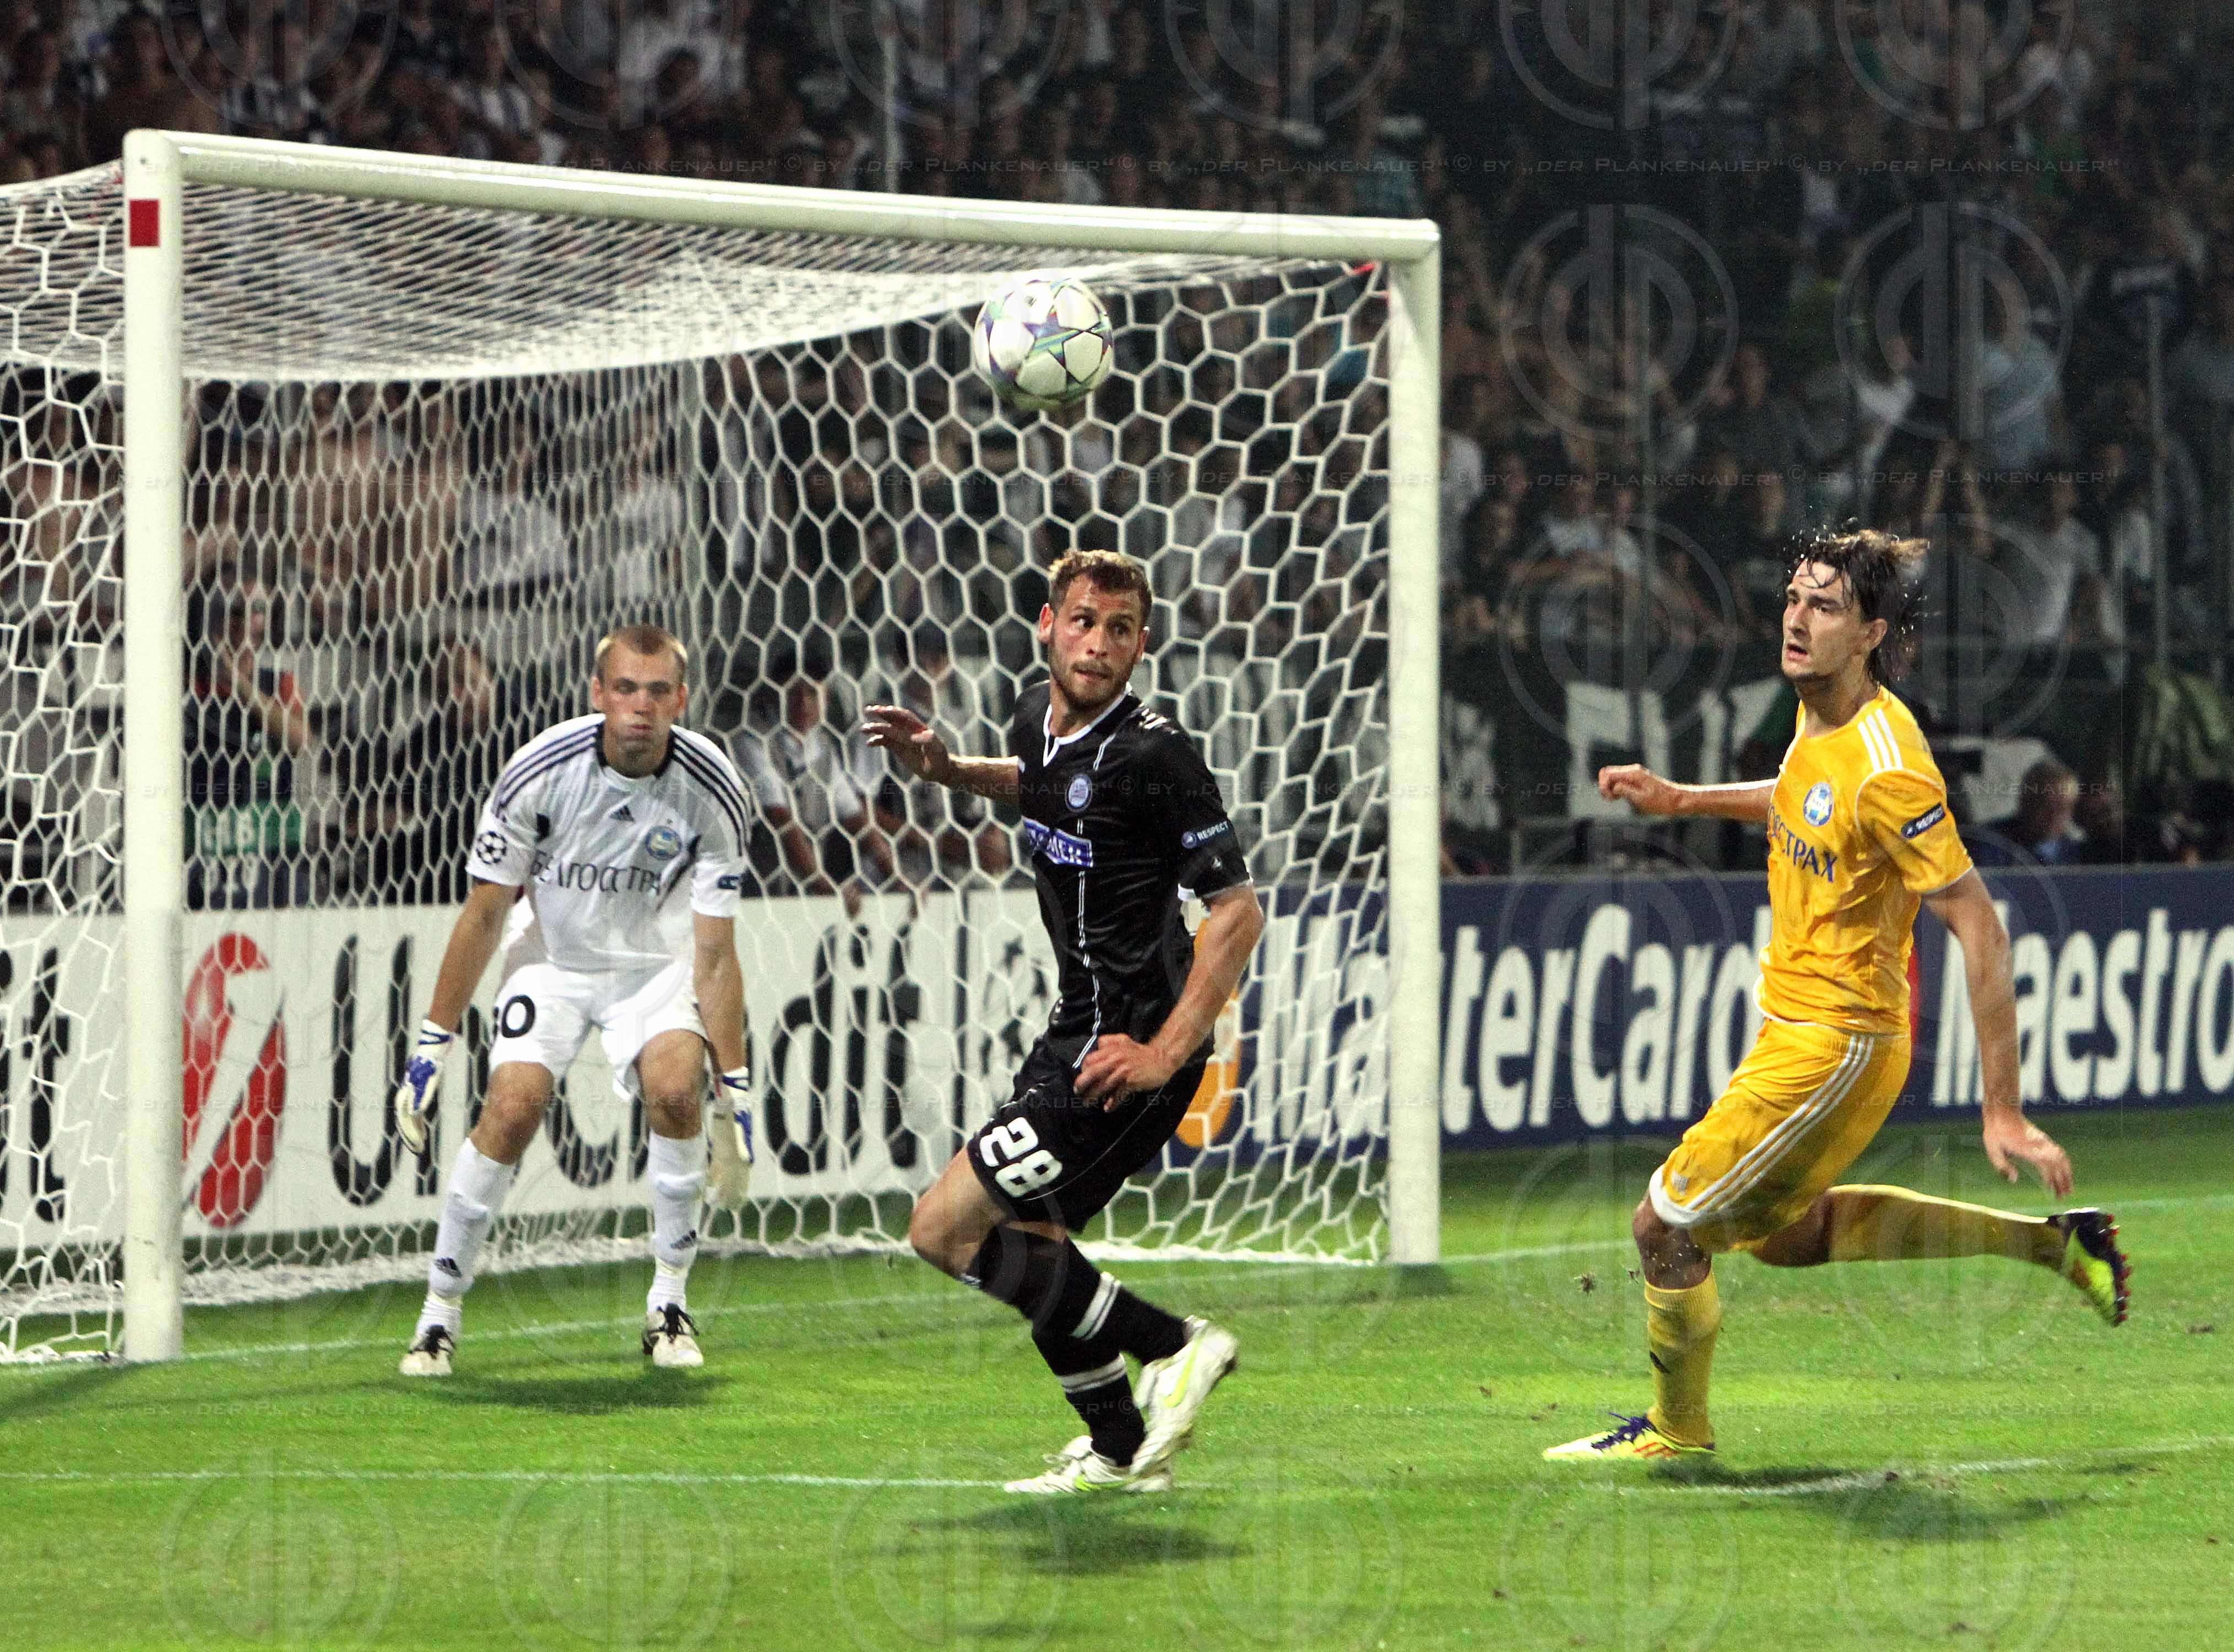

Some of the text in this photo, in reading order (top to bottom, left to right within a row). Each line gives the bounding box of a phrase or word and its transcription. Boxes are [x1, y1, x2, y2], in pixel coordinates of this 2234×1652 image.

[1196, 820, 1229, 841] RESPECT
[1250, 903, 1773, 1144] MaterCard
[979, 1116, 1063, 1198] 28
